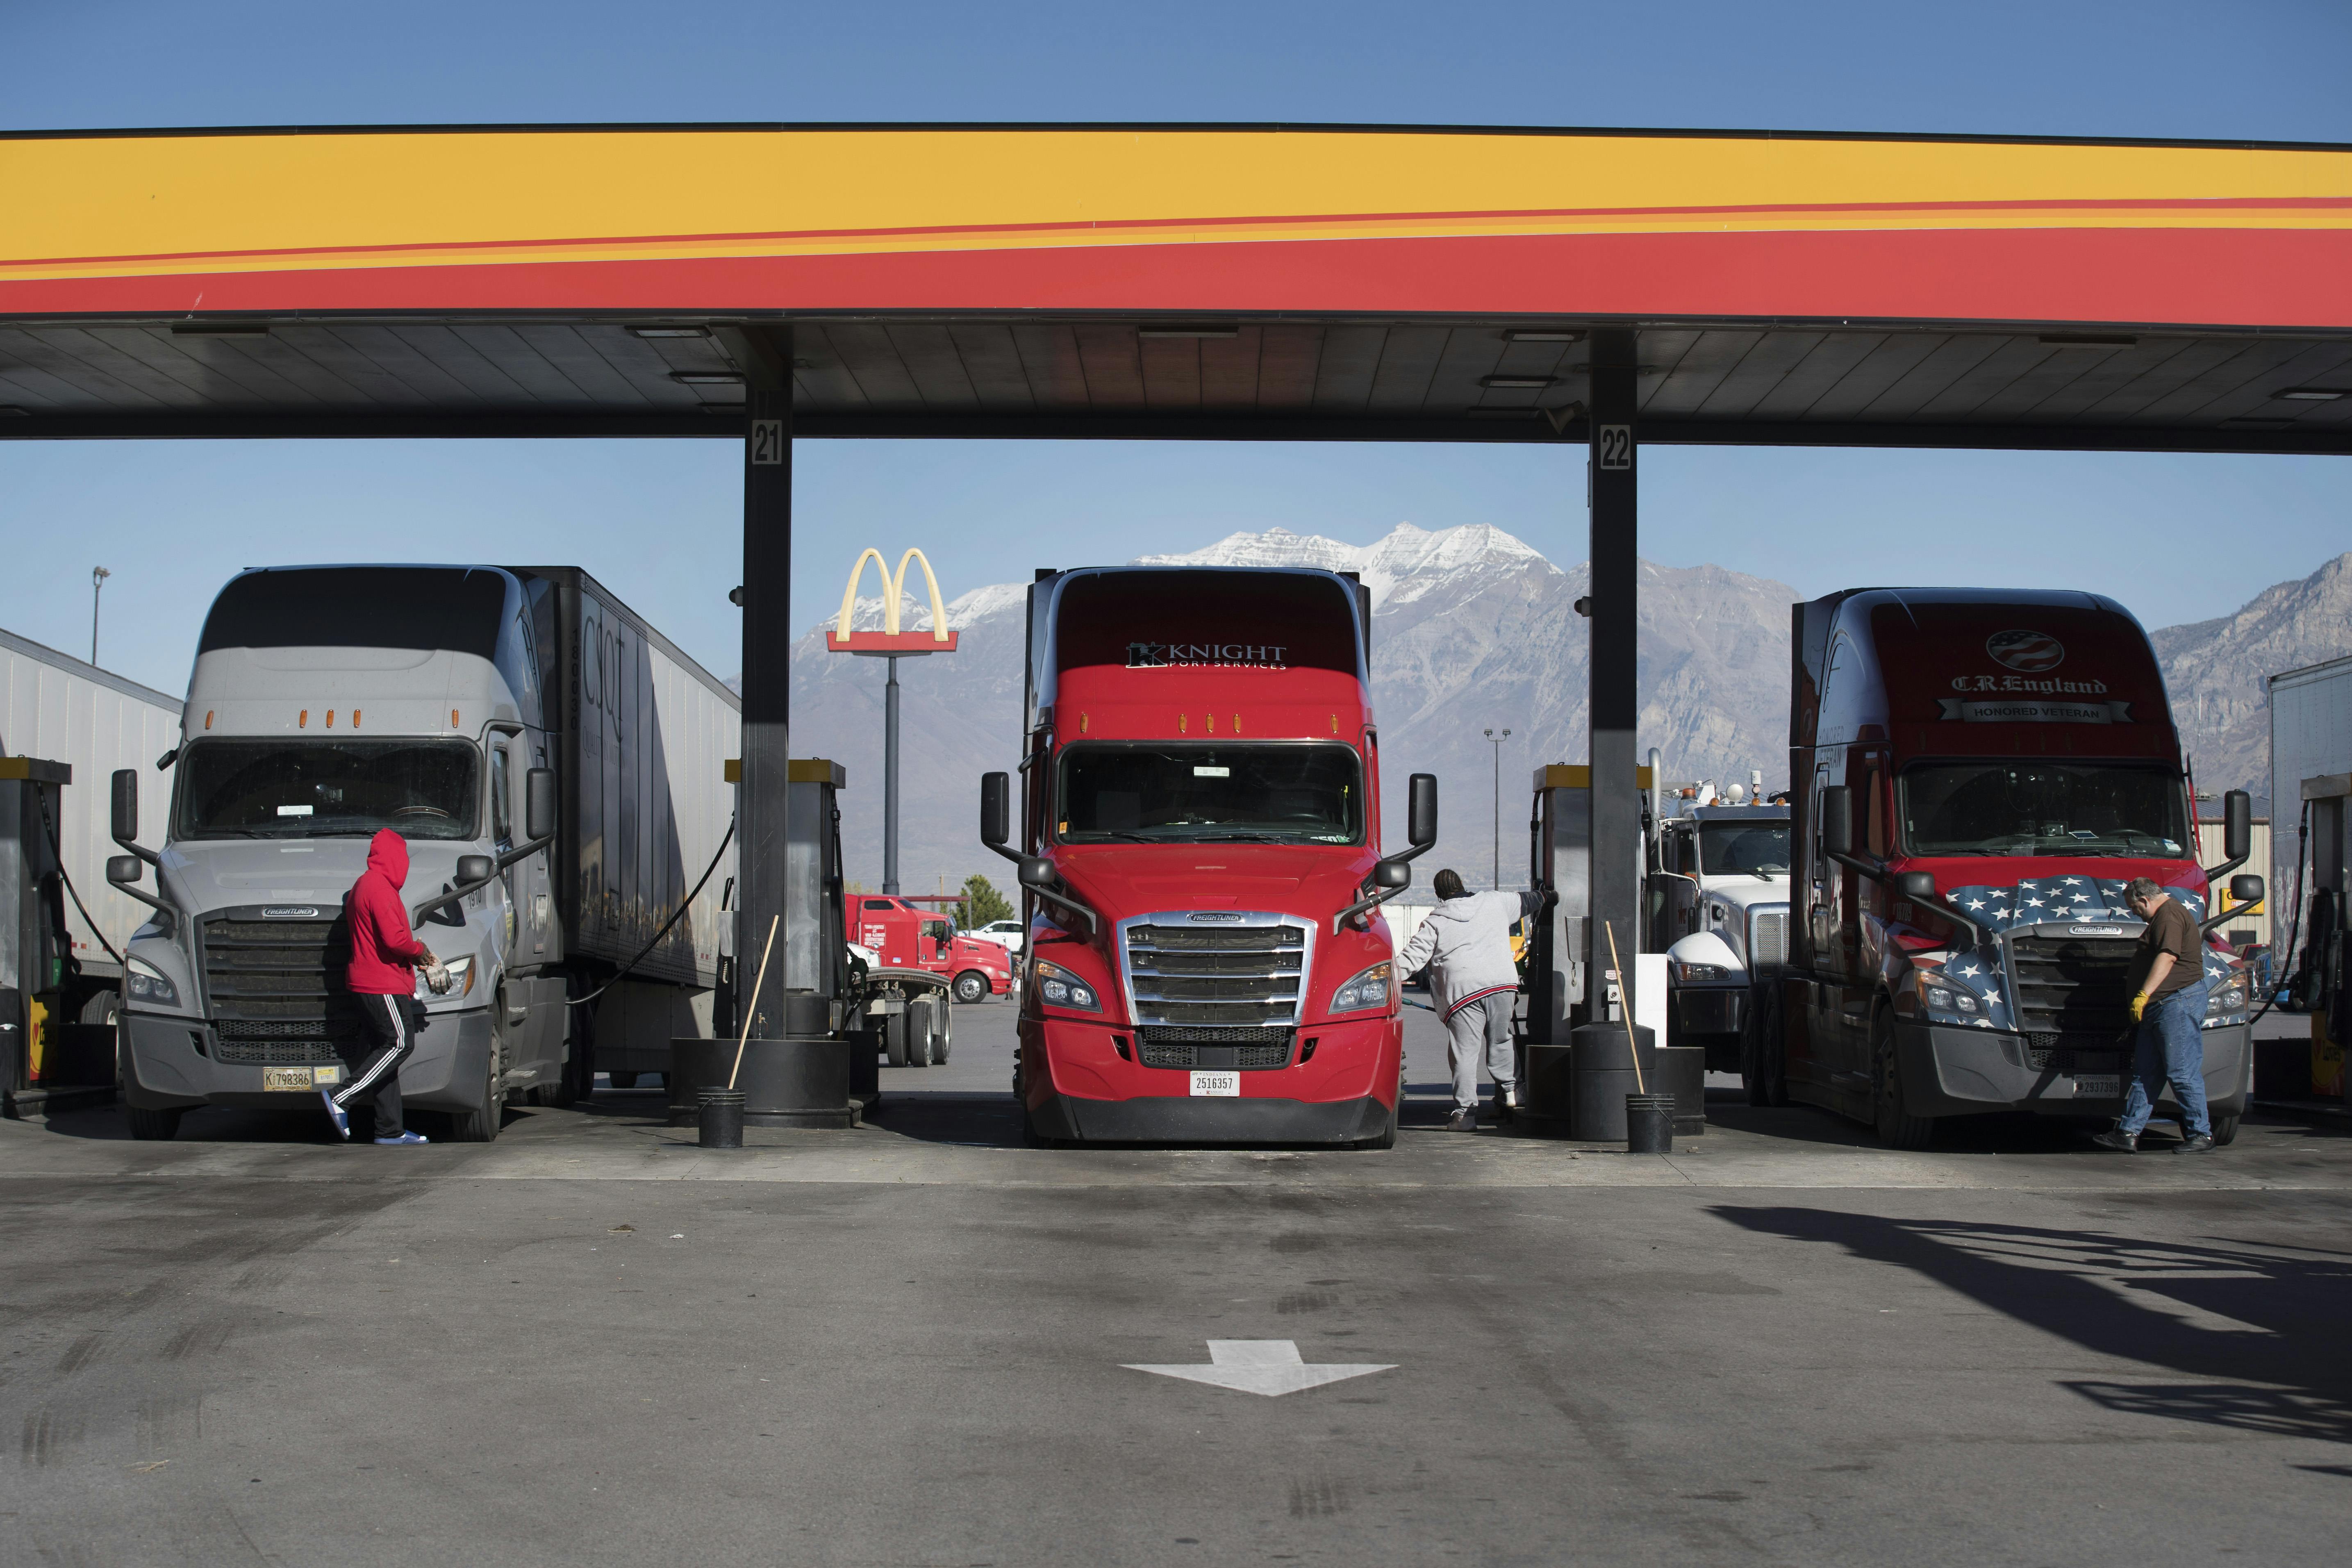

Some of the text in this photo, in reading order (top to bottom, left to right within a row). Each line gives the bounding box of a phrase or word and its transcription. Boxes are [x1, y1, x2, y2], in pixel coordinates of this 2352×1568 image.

[755, 424, 778, 461] 21
[1602, 429, 1629, 466] 22
[1168, 644, 1287, 661] KNIGHT
[1214, 661, 1286, 670] SERVICES
[1974, 708, 2100, 718] HONORED VETERAN
[1818, 726, 1844, 745] HONORED
[1817, 746, 1842, 770] VETERAN
[1896, 902, 1912, 922] 18789
[266, 1073, 272, 1086] K
[276, 1073, 309, 1086] 798386
[1196, 1078, 1233, 1089] 2516357
[2085, 1082, 2118, 1092] 2937396
